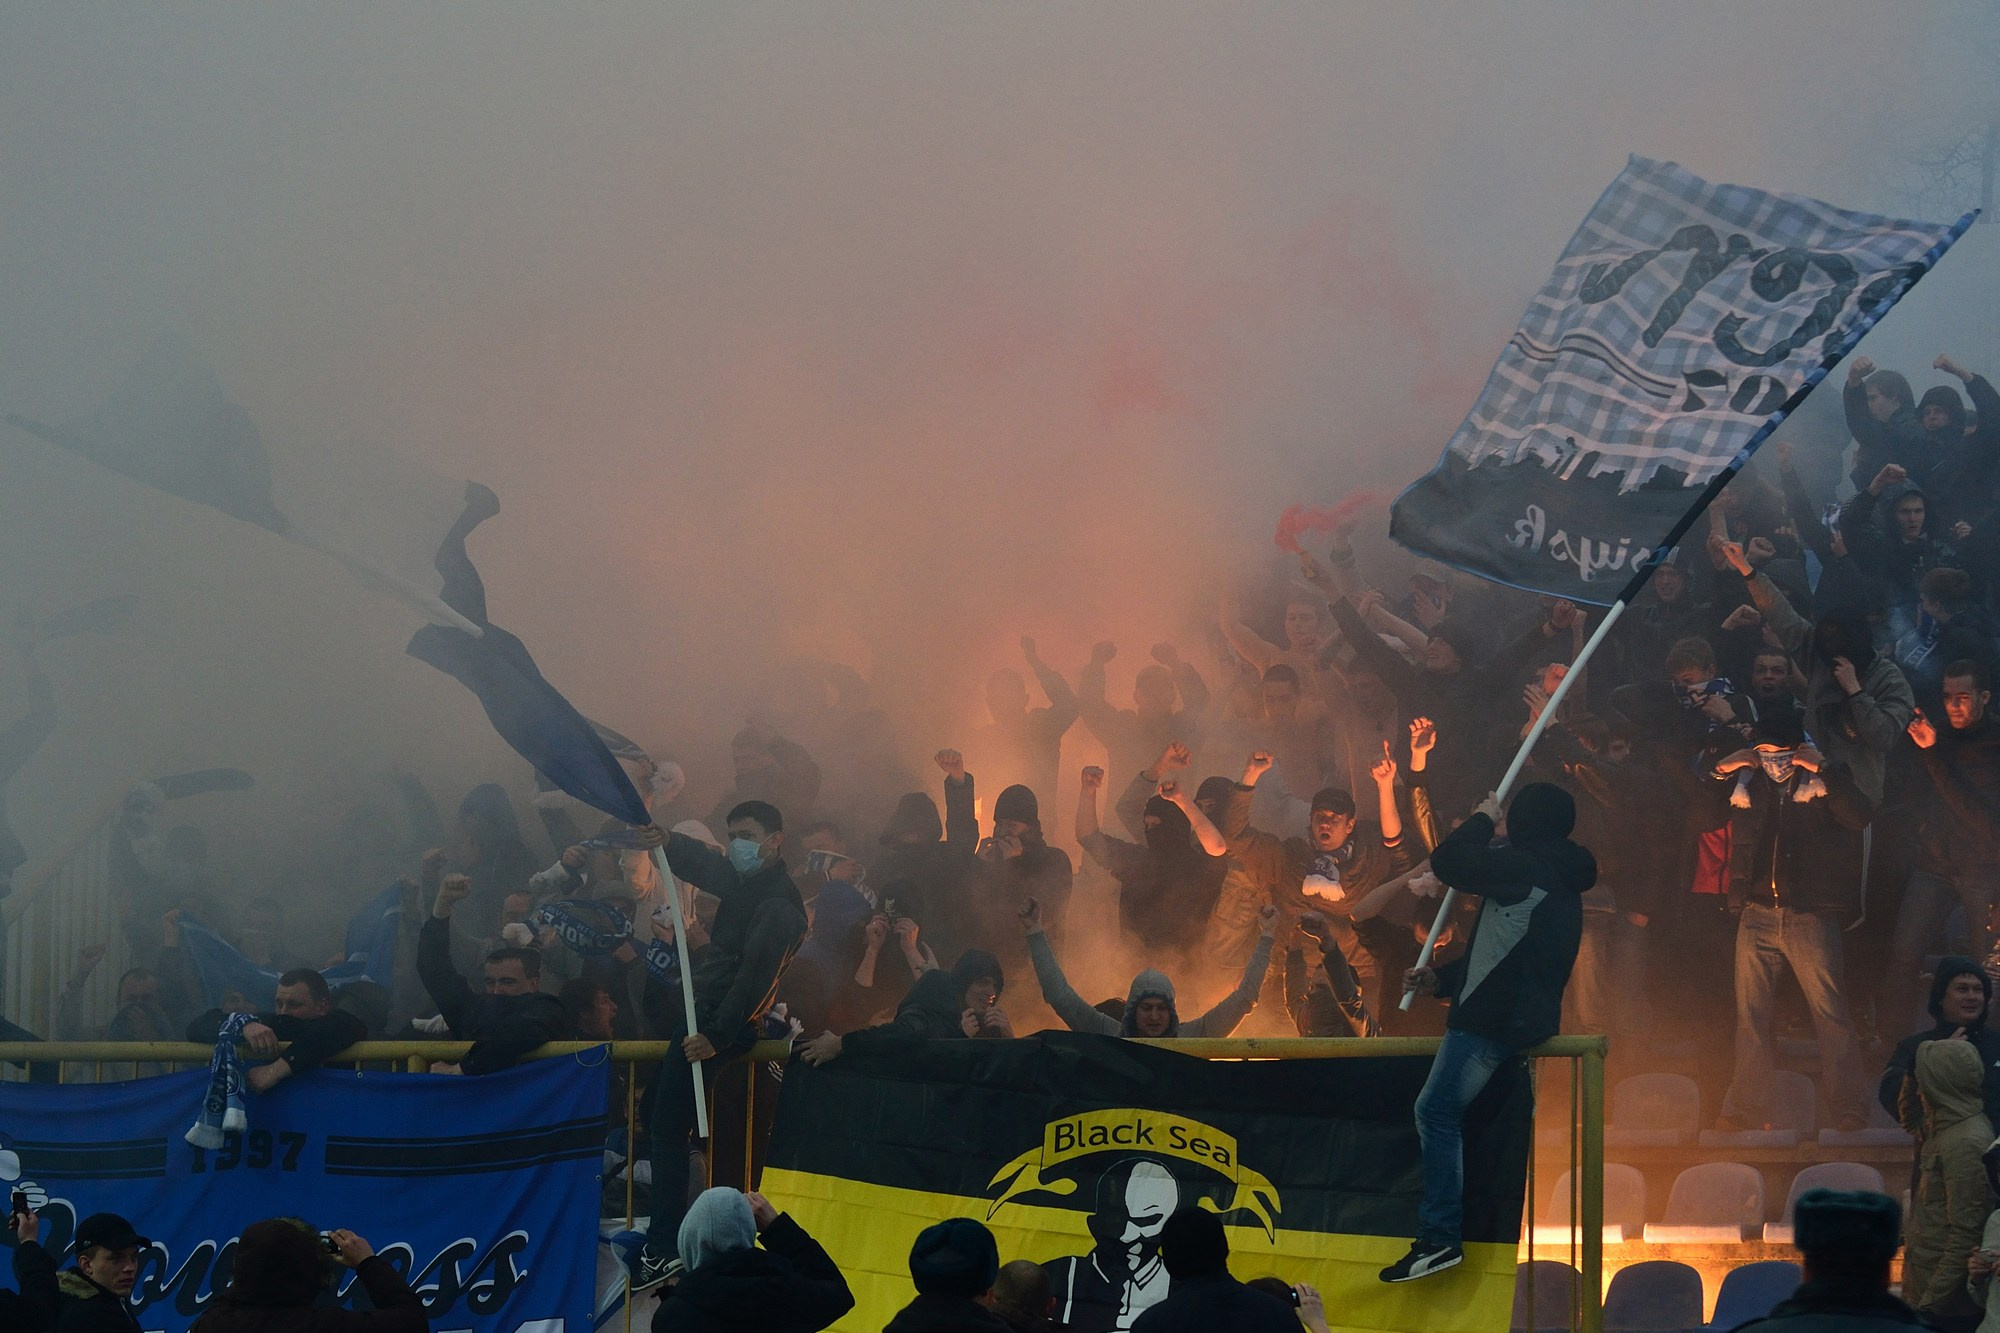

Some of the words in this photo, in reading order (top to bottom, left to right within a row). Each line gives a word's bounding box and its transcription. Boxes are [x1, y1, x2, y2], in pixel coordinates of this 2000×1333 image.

[189, 1129, 307, 1174] 1997
[1053, 1118, 1155, 1154] Black
[1168, 1125, 1231, 1168] Sea
